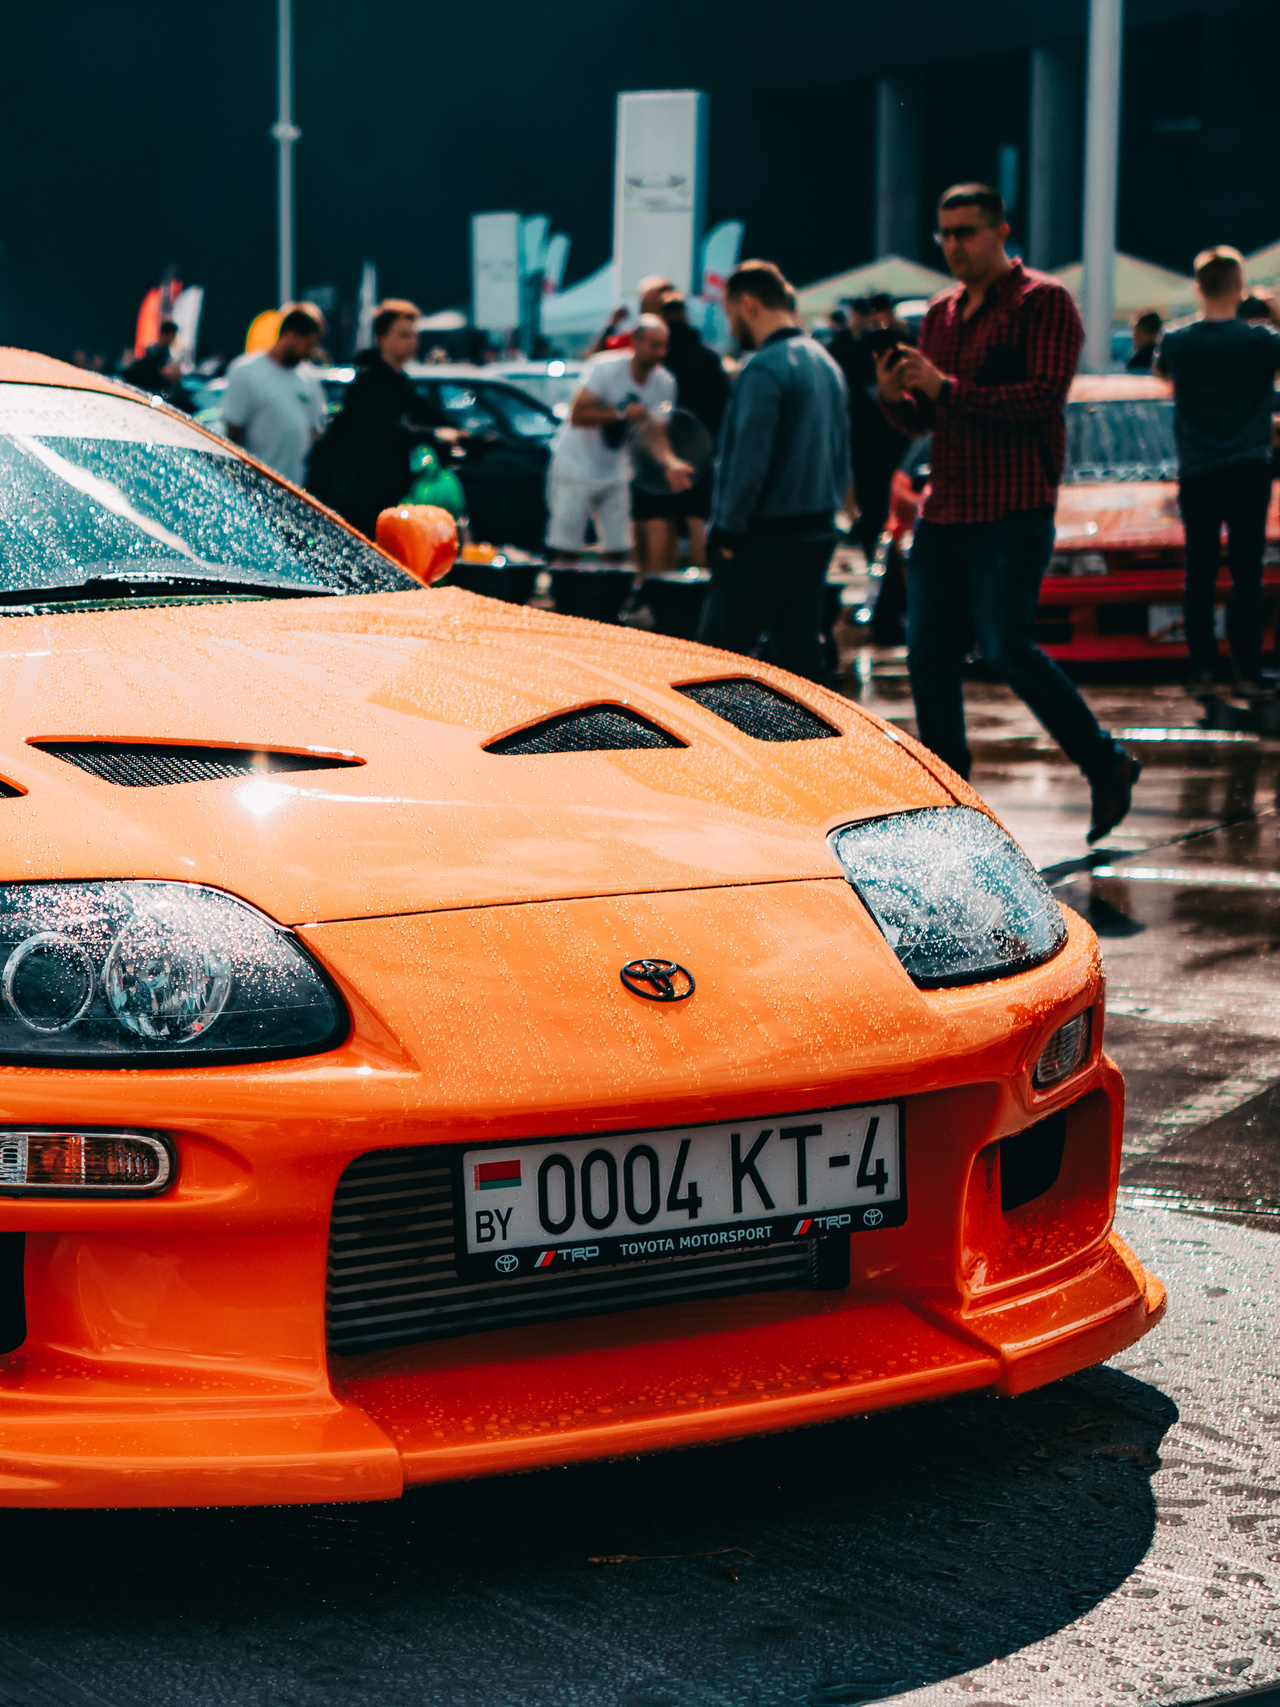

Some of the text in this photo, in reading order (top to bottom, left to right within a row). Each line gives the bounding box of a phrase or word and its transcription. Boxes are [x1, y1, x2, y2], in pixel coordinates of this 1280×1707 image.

[537, 1116, 889, 1235] 0004 KT-4
[475, 1207, 514, 1244] BY
[813, 1213, 851, 1230] TRD
[557, 1245, 600, 1263] TRD
[619, 1225, 773, 1256] TOYOTA MOTORSPORT
